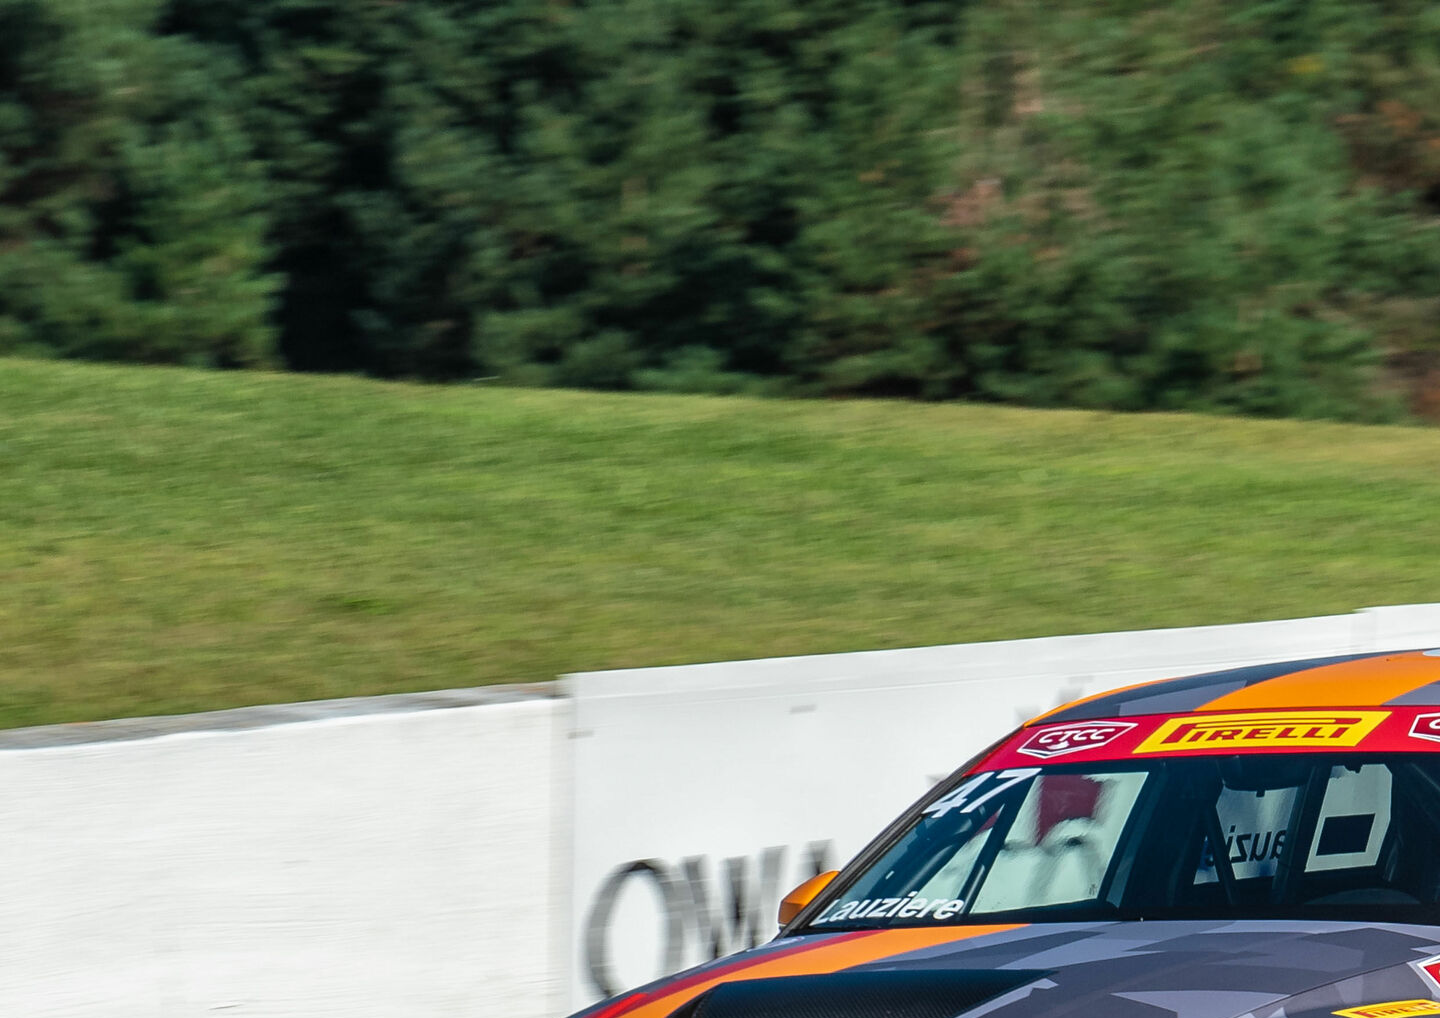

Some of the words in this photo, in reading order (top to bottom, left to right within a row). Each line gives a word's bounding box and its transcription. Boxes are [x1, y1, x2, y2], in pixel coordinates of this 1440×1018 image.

[1038, 728, 1116, 744] CTCC
[1160, 716, 1363, 744] PIRELLI
[922, 768, 1042, 818] 47
[809, 891, 964, 926] Lauziere
